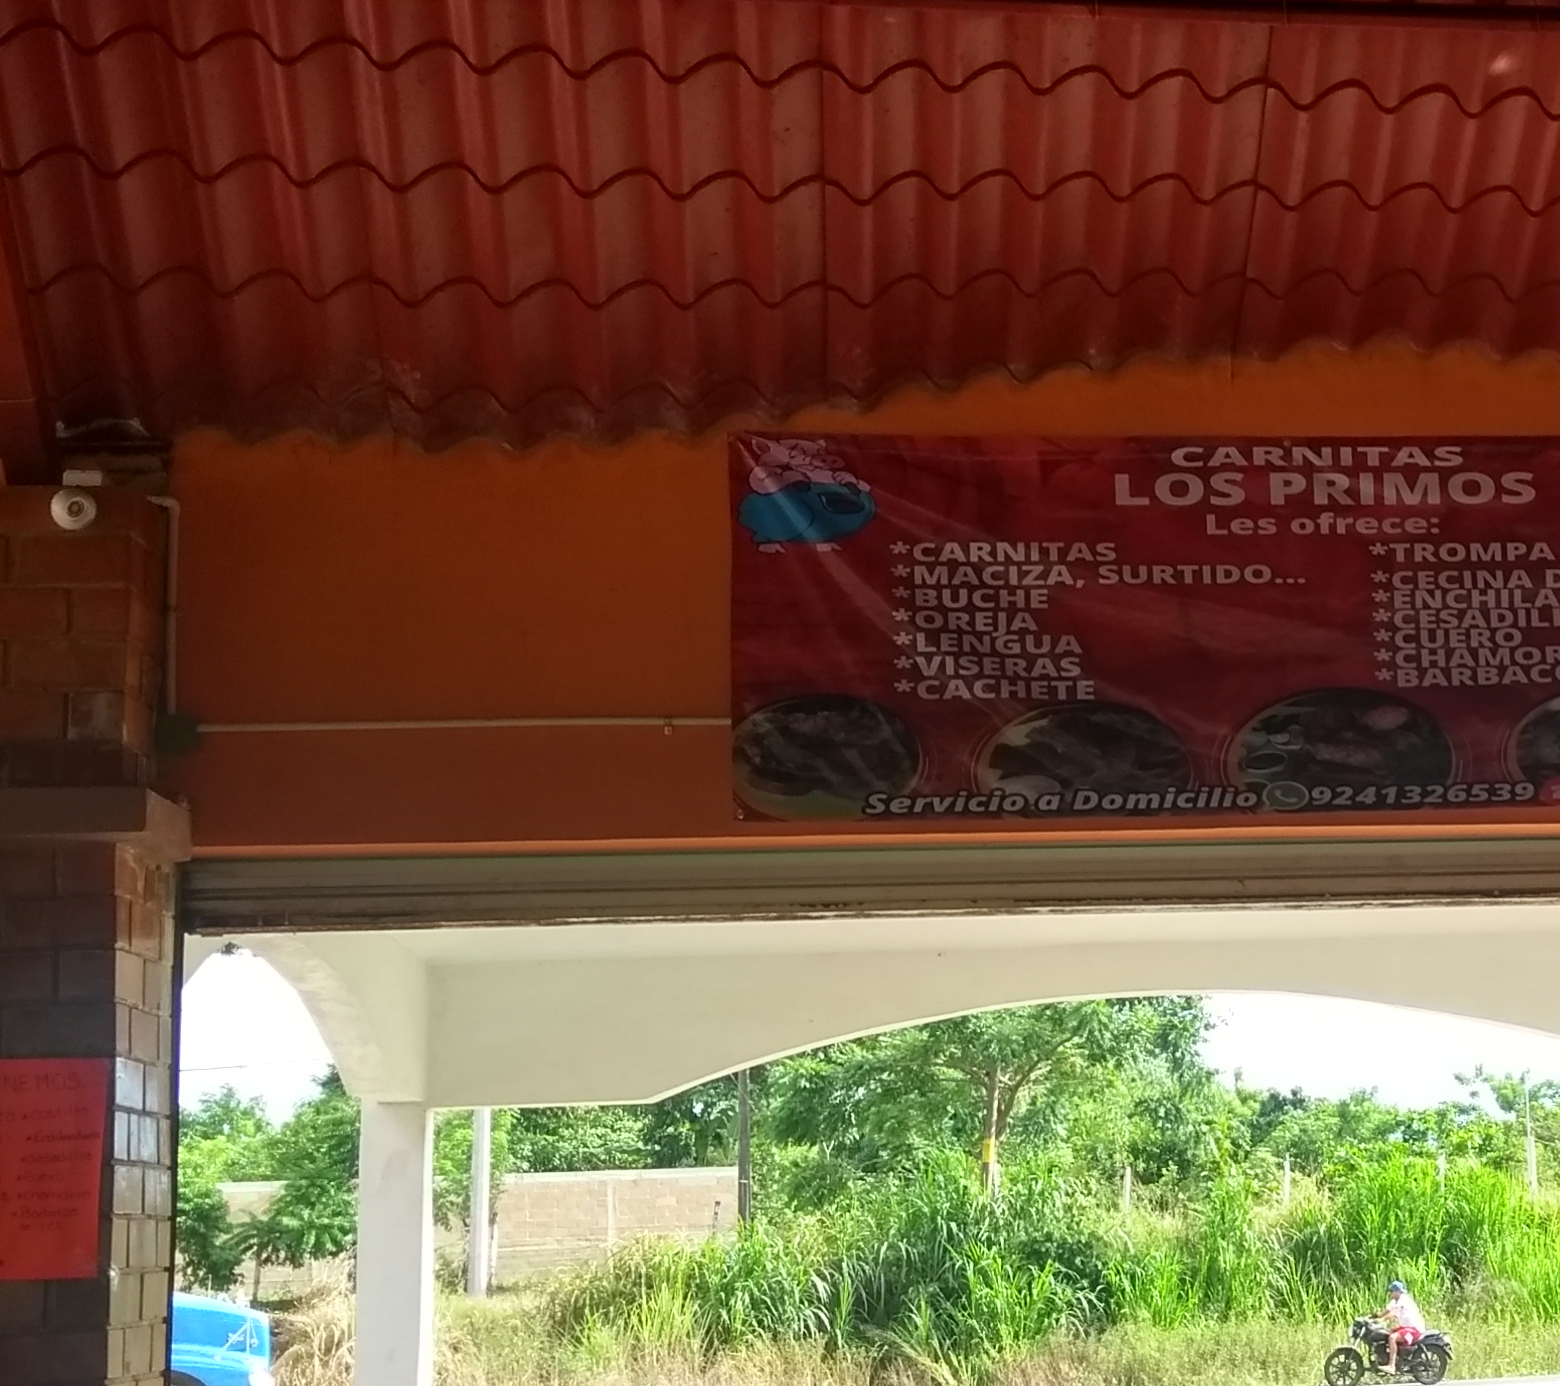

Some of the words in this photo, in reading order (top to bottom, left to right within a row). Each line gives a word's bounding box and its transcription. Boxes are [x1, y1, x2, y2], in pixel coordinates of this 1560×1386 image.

[1170, 446, 1464, 468] CARNITAS
[1114, 472, 1245, 506] LOS
[1269, 471, 1537, 506] PRIMOS
[1205, 514, 1277, 535] Les
[1290, 512, 1440, 535] ofrece:
[913, 542, 1117, 562] CARNITAS
[1390, 542, 1555, 562] TROMPA
[914, 565, 1085, 588] MACIZA,
[1392, 570, 1533, 590] CECINA
[915, 588, 1049, 609] BUCHE
[915, 611, 1038, 637] OREJA
[916, 633, 1083, 654] LENGUA
[1394, 628, 1522, 648] CUERO
[915, 656, 1081, 677] VISERAS
[917, 679, 1096, 700] CACHETE
[865, 788, 1025, 814] Servicio
[1038, 794, 1059, 810] a
[1073, 785, 1257, 811] Domicilio
[1311, 782, 1535, 806] 9241326539
